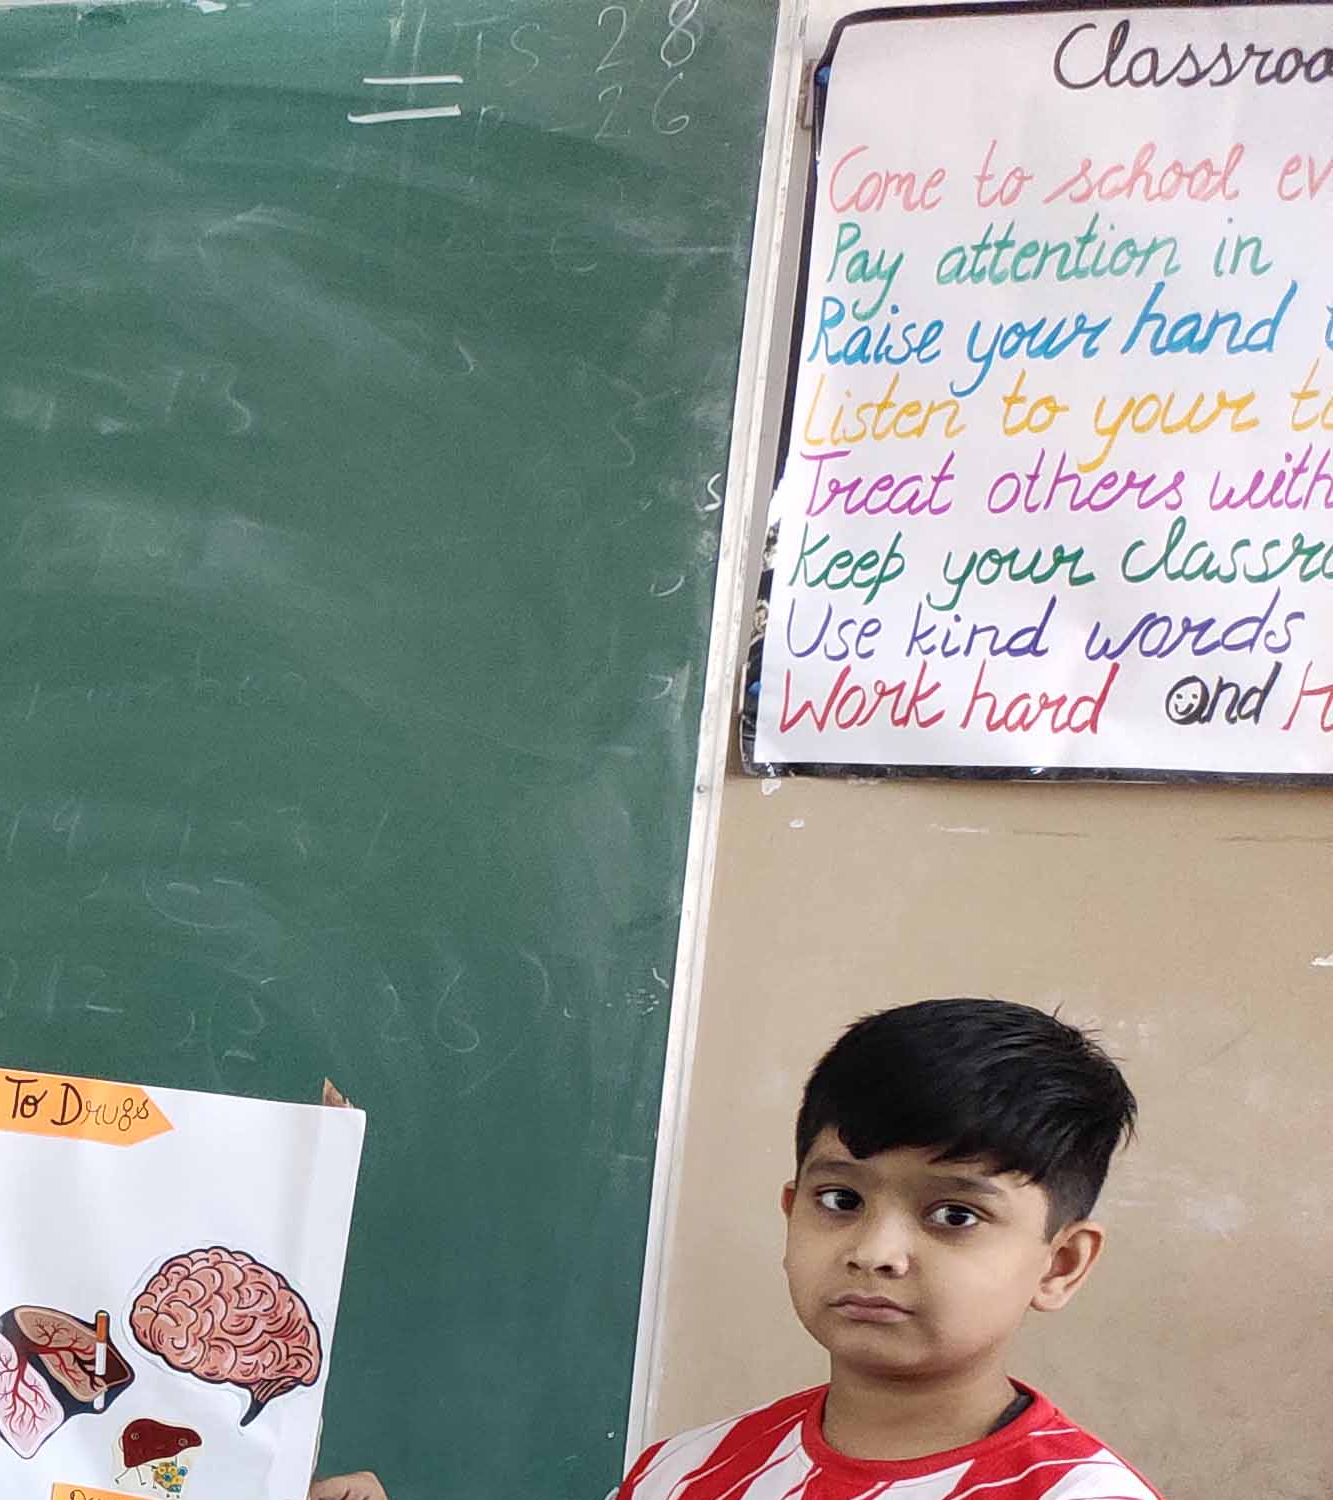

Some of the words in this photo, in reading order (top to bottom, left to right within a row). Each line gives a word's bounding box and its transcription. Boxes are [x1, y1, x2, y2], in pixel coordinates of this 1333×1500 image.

[829, 144, 946, 213] Come
[974, 139, 1033, 208] to
[1043, 140, 1245, 203] school
[826, 221, 903, 322] Pay
[937, 212, 1181, 286] attention
[1213, 217, 1273, 278] in
[806, 296, 943, 366] Raise
[949, 314, 1112, 398] your
[1121, 280, 1298, 357] hand
[804, 372, 966, 446] Listen
[1001, 370, 1069, 435] to
[1077, 390, 1260, 473] your
[800, 449, 956, 517] Treat
[987, 448, 1185, 513] others
[787, 522, 906, 605] Keep
[926, 544, 1096, 612] your
[785, 597, 883, 662] Use
[906, 594, 1057, 659] kind
[1085, 586, 1306, 662] words
[778, 659, 948, 734] Work
[959, 662, 1120, 735] hard
[5, 1075, 49, 1119] To
[50, 1082, 151, 1132] Drugs
